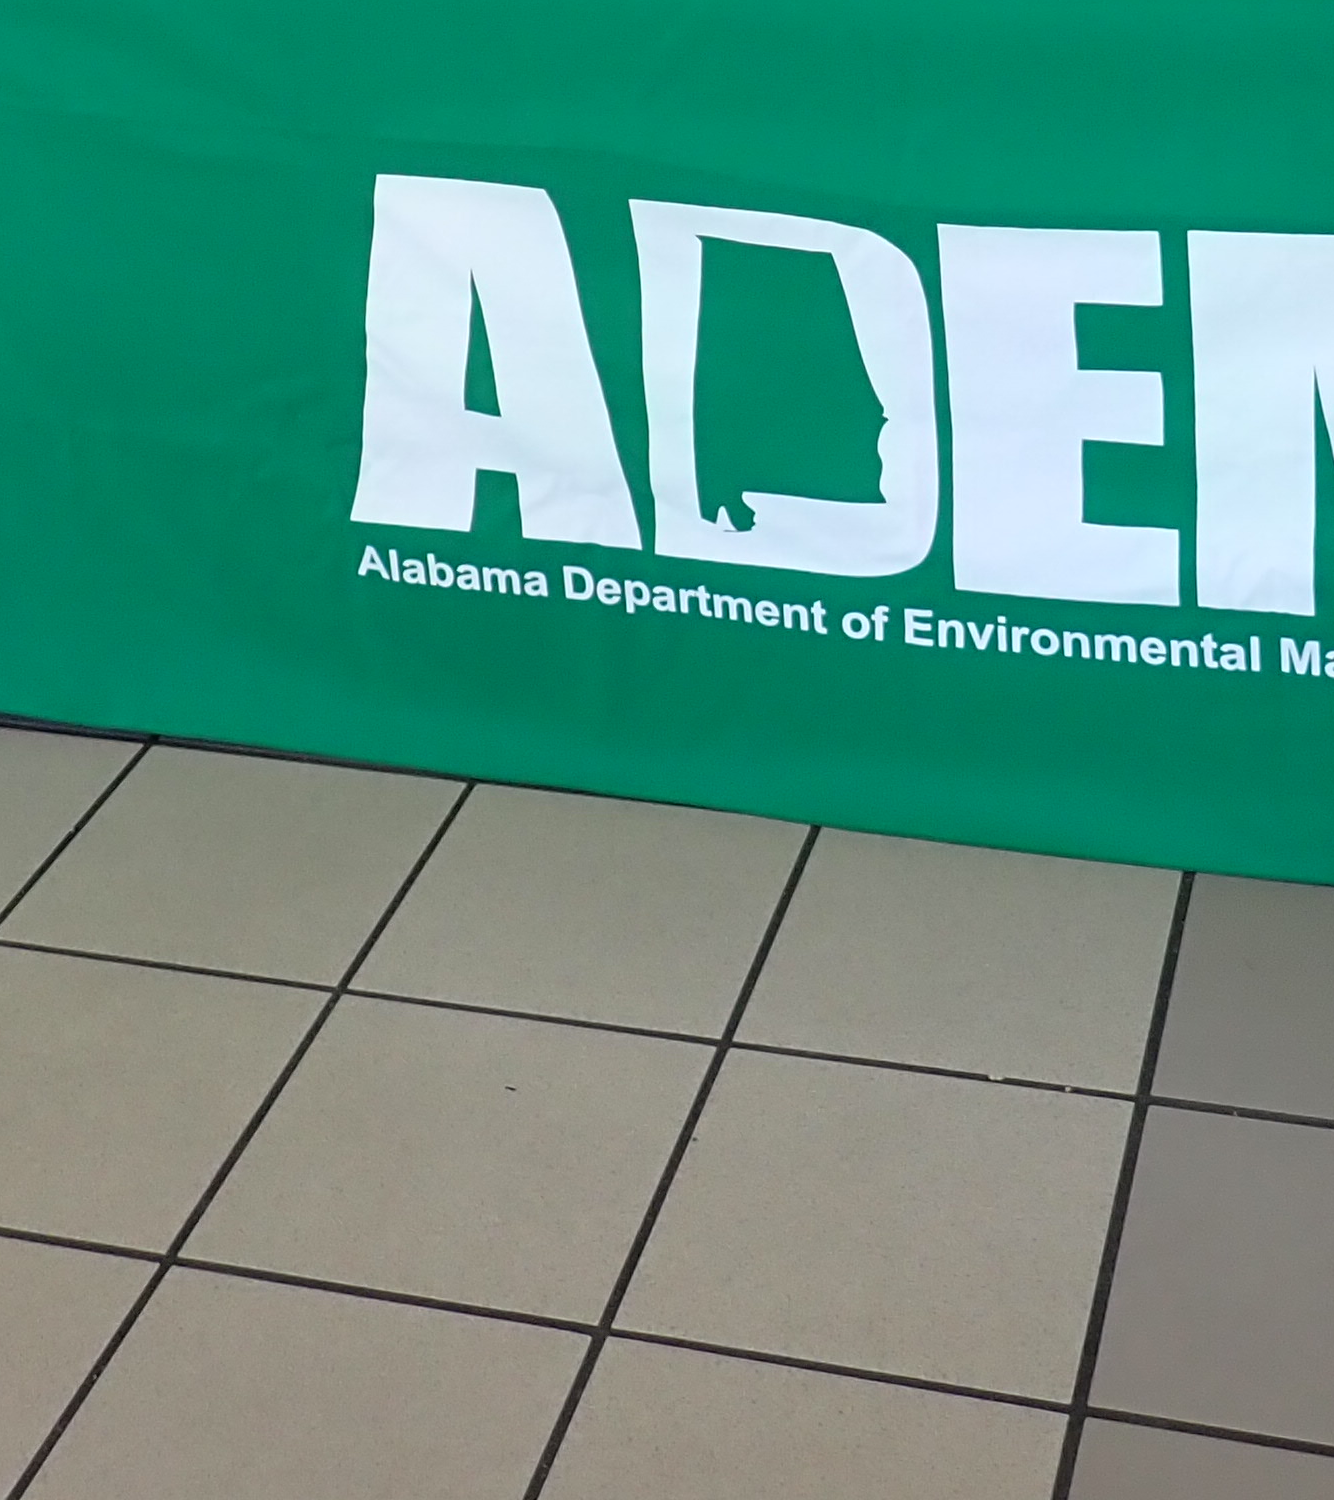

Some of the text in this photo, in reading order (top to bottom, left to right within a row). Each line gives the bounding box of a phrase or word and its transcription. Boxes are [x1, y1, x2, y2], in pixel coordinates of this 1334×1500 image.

[357, 545, 549, 597] Alabama
[562, 565, 828, 634] Department
[841, 607, 889, 642] of
[903, 608, 1262, 673] Environmental
